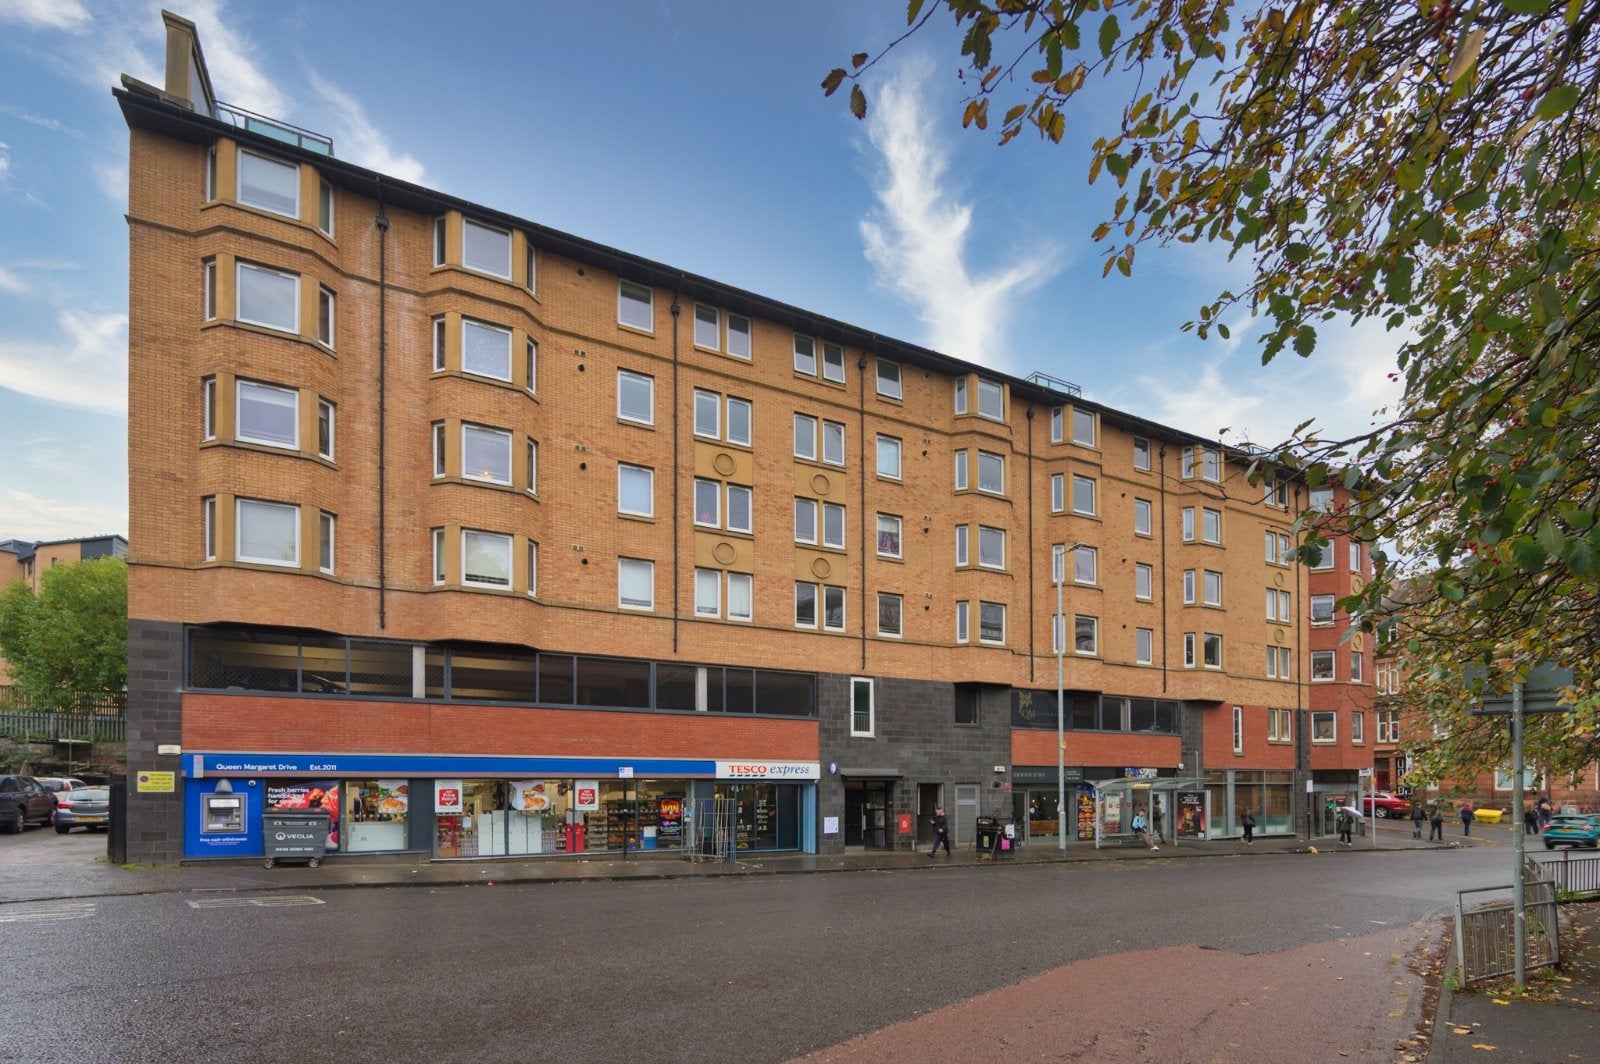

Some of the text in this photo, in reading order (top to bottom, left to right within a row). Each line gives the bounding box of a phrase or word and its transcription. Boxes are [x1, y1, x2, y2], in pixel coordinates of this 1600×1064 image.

[216, 763, 242, 771] Queen
[244, 764, 277, 772] Margaret
[728, 765, 809, 776] TESCO express
